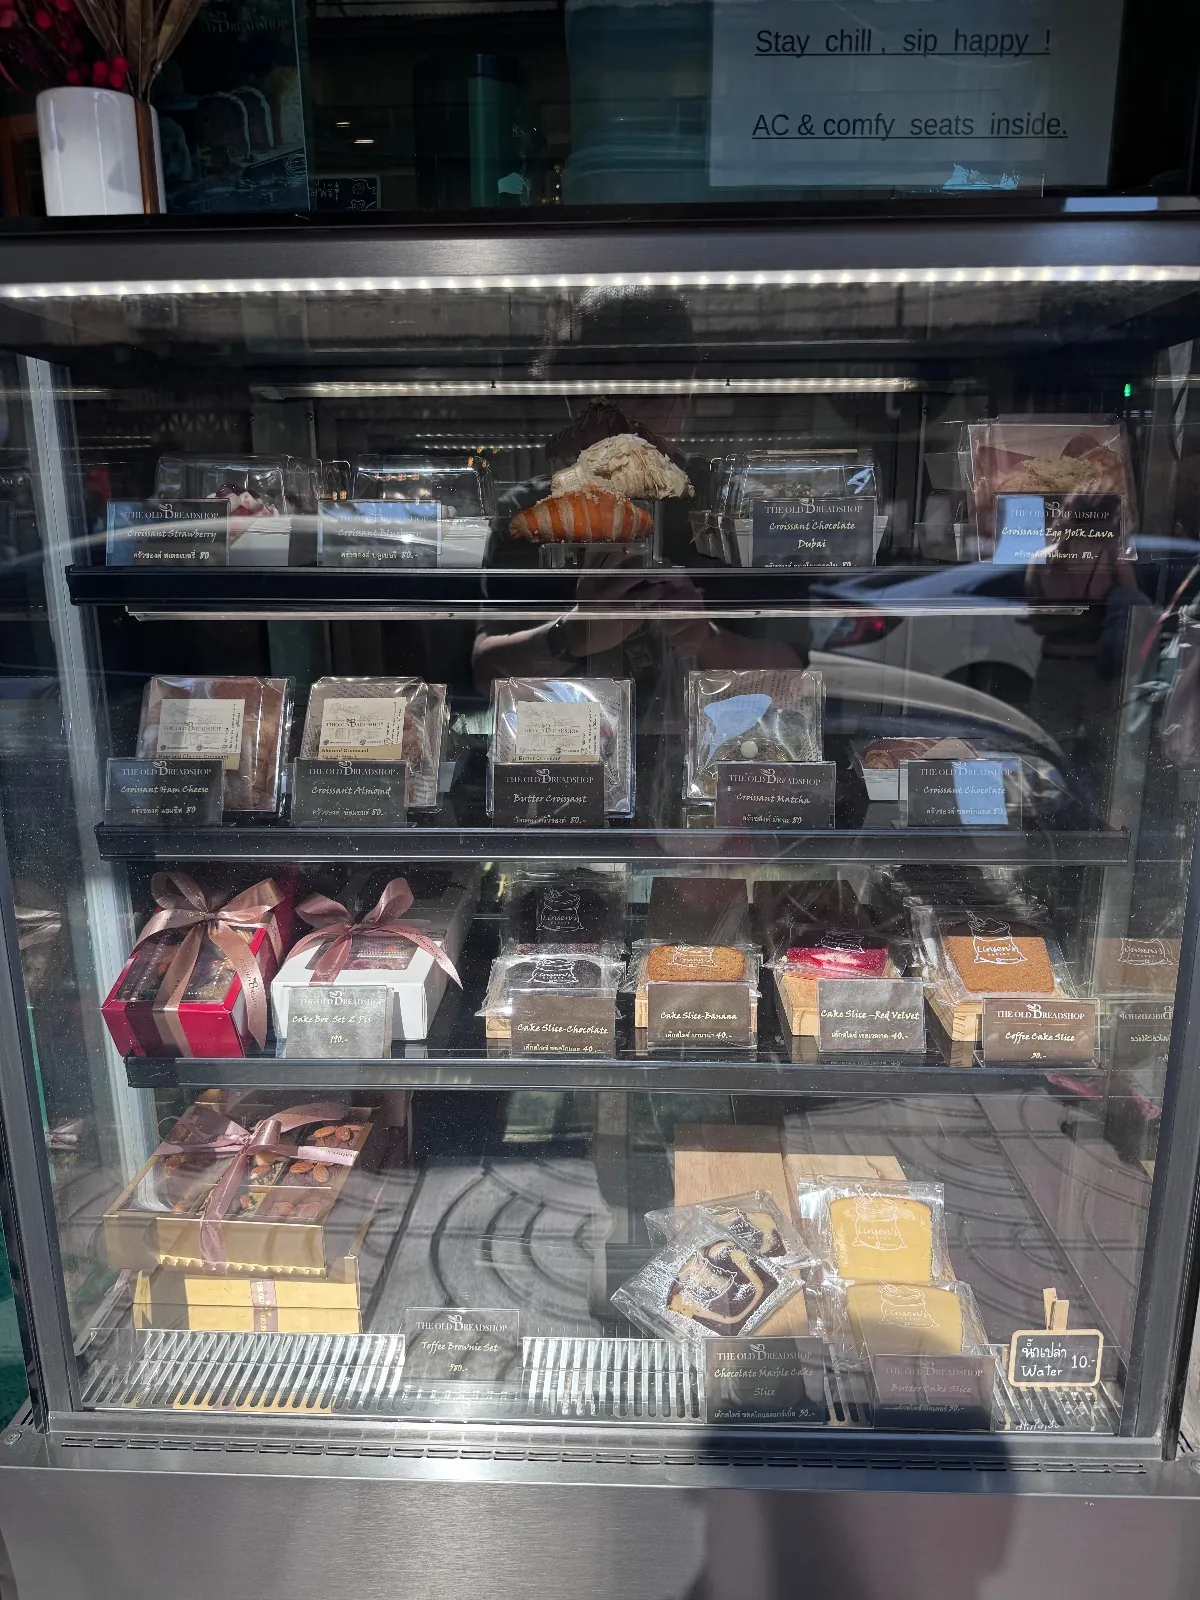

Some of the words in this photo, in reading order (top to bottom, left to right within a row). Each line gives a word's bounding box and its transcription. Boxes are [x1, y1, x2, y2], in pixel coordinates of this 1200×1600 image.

[756, 29, 810, 57] Stay
[825, 29, 871, 52] chill
[902, 29, 937, 57] sip
[954, 29, 1029, 57] happy
[752, 114, 789, 137] AC
[797, 115, 815, 136] &
[823, 113, 894, 141] comfy
[910, 115, 974, 136] seats
[990, 113, 1068, 137] inside.
[125, 511, 146, 519] THE
[147, 511, 164, 519] OLD
[161, 504, 218, 519] BREADSHOP
[764, 506, 784, 514] THE
[785, 506, 804, 514] OLD
[802, 498, 863, 514] BREADSHOP
[769, 522, 809, 531] Croissant
[812, 522, 855, 530] Chocolate
[127, 529, 167, 537] Croissant
[168, 528, 217, 542] Strawberry
[1001, 526, 1044, 536] Croissant
[1045, 527, 1062, 542] Egg
[1065, 527, 1086, 541] Yolk
[1087, 528, 1115, 538] Lava
[797, 540, 826, 548] Dubai
[199, 551, 210, 560] 80
[1081, 551, 1099, 559] 80.-
[121, 768, 139, 776] THE
[140, 768, 157, 776] OLD
[156, 761, 212, 776] BREADSHOP
[341, 761, 396, 776] BREADSHOP
[919, 768, 938, 776] THE
[938, 768, 957, 776] OLD
[540, 768, 594, 784] BREADSHOP
[728, 774, 746, 782] THE
[747, 775, 766, 784] OLD
[764, 769, 821, 786] BREADSHOP
[121, 786, 159, 794] Croissant
[160, 786, 180, 794] Ham
[182, 785, 209, 794] Cheese
[311, 786, 353, 795] Croissant
[353, 787, 392, 797] Almond
[923, 785, 963, 795] Croissant
[964, 786, 1006, 795] Chocolate
[513, 793, 544, 803] Butter
[545, 794, 588, 803] Croissant
[736, 793, 775, 803] Croissant
[777, 794, 811, 804] Matcha
[660, 1011, 681, 1020] Cake
[820, 1009, 844, 1018] Cake
[845, 1009, 867, 1019] Slice
[891, 1011, 920, 1020] Velvet
[996, 1010, 1014, 1018] THE
[1014, 1011, 1032, 1019] OLD
[1029, 1004, 1085, 1020] BREADSHOP
[292, 1014, 313, 1023] Cake
[314, 1015, 329, 1023] Box
[331, 1015, 346, 1023] Set
[517, 1023, 541, 1032] Cake
[1005, 1032, 1031, 1044] Coffee
[1031, 1032, 1053, 1041] Cake
[1054, 1032, 1075, 1042] Slice
[415, 1321, 434, 1330] THE
[434, 1322, 453, 1331] OLD
[450, 1314, 508, 1332] BREADSHOP
[422, 1341, 446, 1355] Toffee
[447, 1342, 482, 1352] Brownie
[483, 1343, 499, 1352] Set
[1021, 1338, 1067, 1358] น้ำเปล่า
[1071, 1355, 1096, 1369] 10.-
[716, 1353, 735, 1361] THE
[737, 1353, 756, 1361] OLD
[714, 1367, 757, 1378] Chocolate
[758, 1367, 789, 1378] Marble
[791, 1367, 814, 1377] Cake
[886, 1367, 903, 1377] THE
[1020, 1364, 1063, 1377] Water
[753, 1387, 776, 1397] Slice
[891, 1384, 922, 1392] Butter
[923, 1384, 948, 1392] Cake
[949, 1384, 972, 1393] Slice
